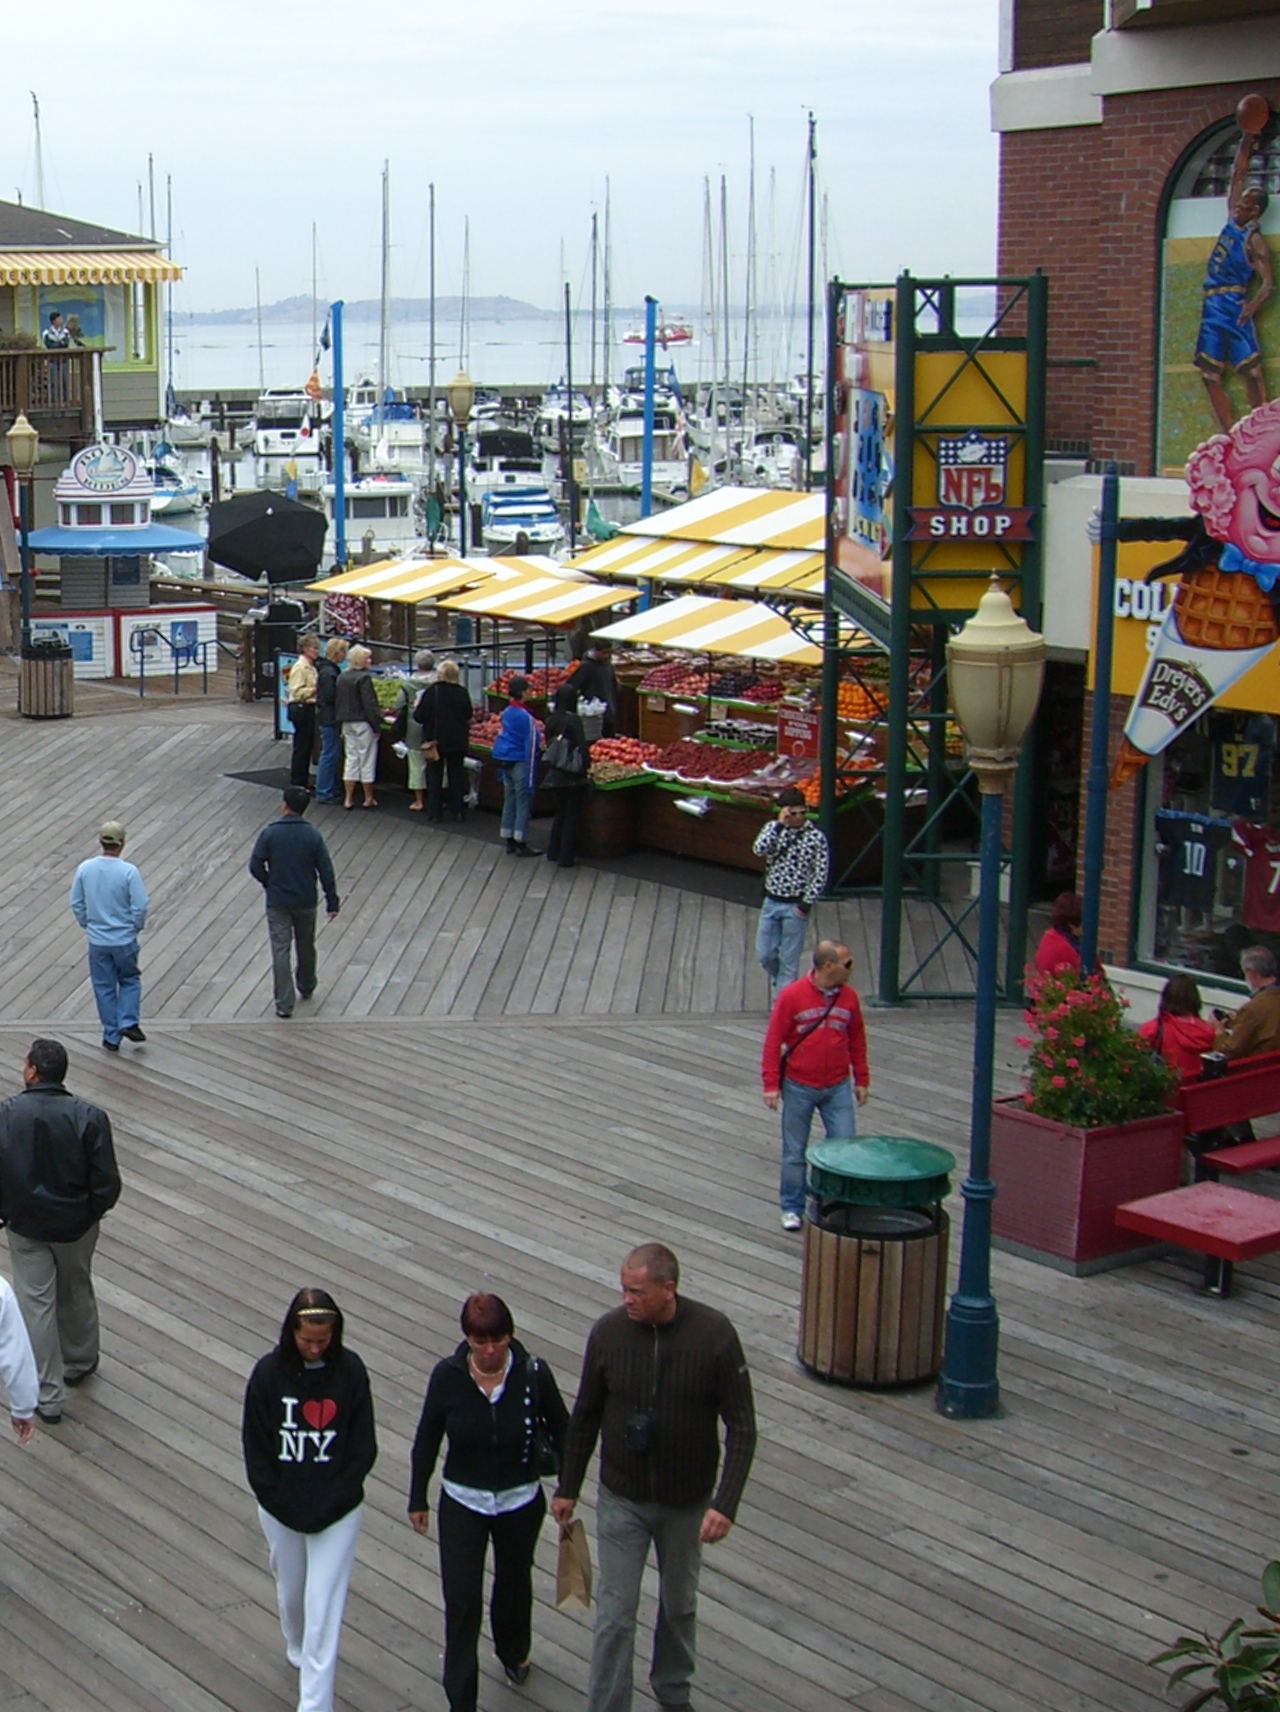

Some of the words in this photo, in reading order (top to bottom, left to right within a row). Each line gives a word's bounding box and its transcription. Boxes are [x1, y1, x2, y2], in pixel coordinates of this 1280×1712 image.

[67, 269, 143, 281] APPAREL
[941, 467, 1003, 509] NFL
[929, 515, 1012, 536] SHOP
[1147, 684, 1188, 722] Edy's
[1221, 743, 1259, 777] 97
[1183, 840, 1207, 877] 10
[280, 1396, 299, 1429] I
[277, 1429, 338, 1463] NY
